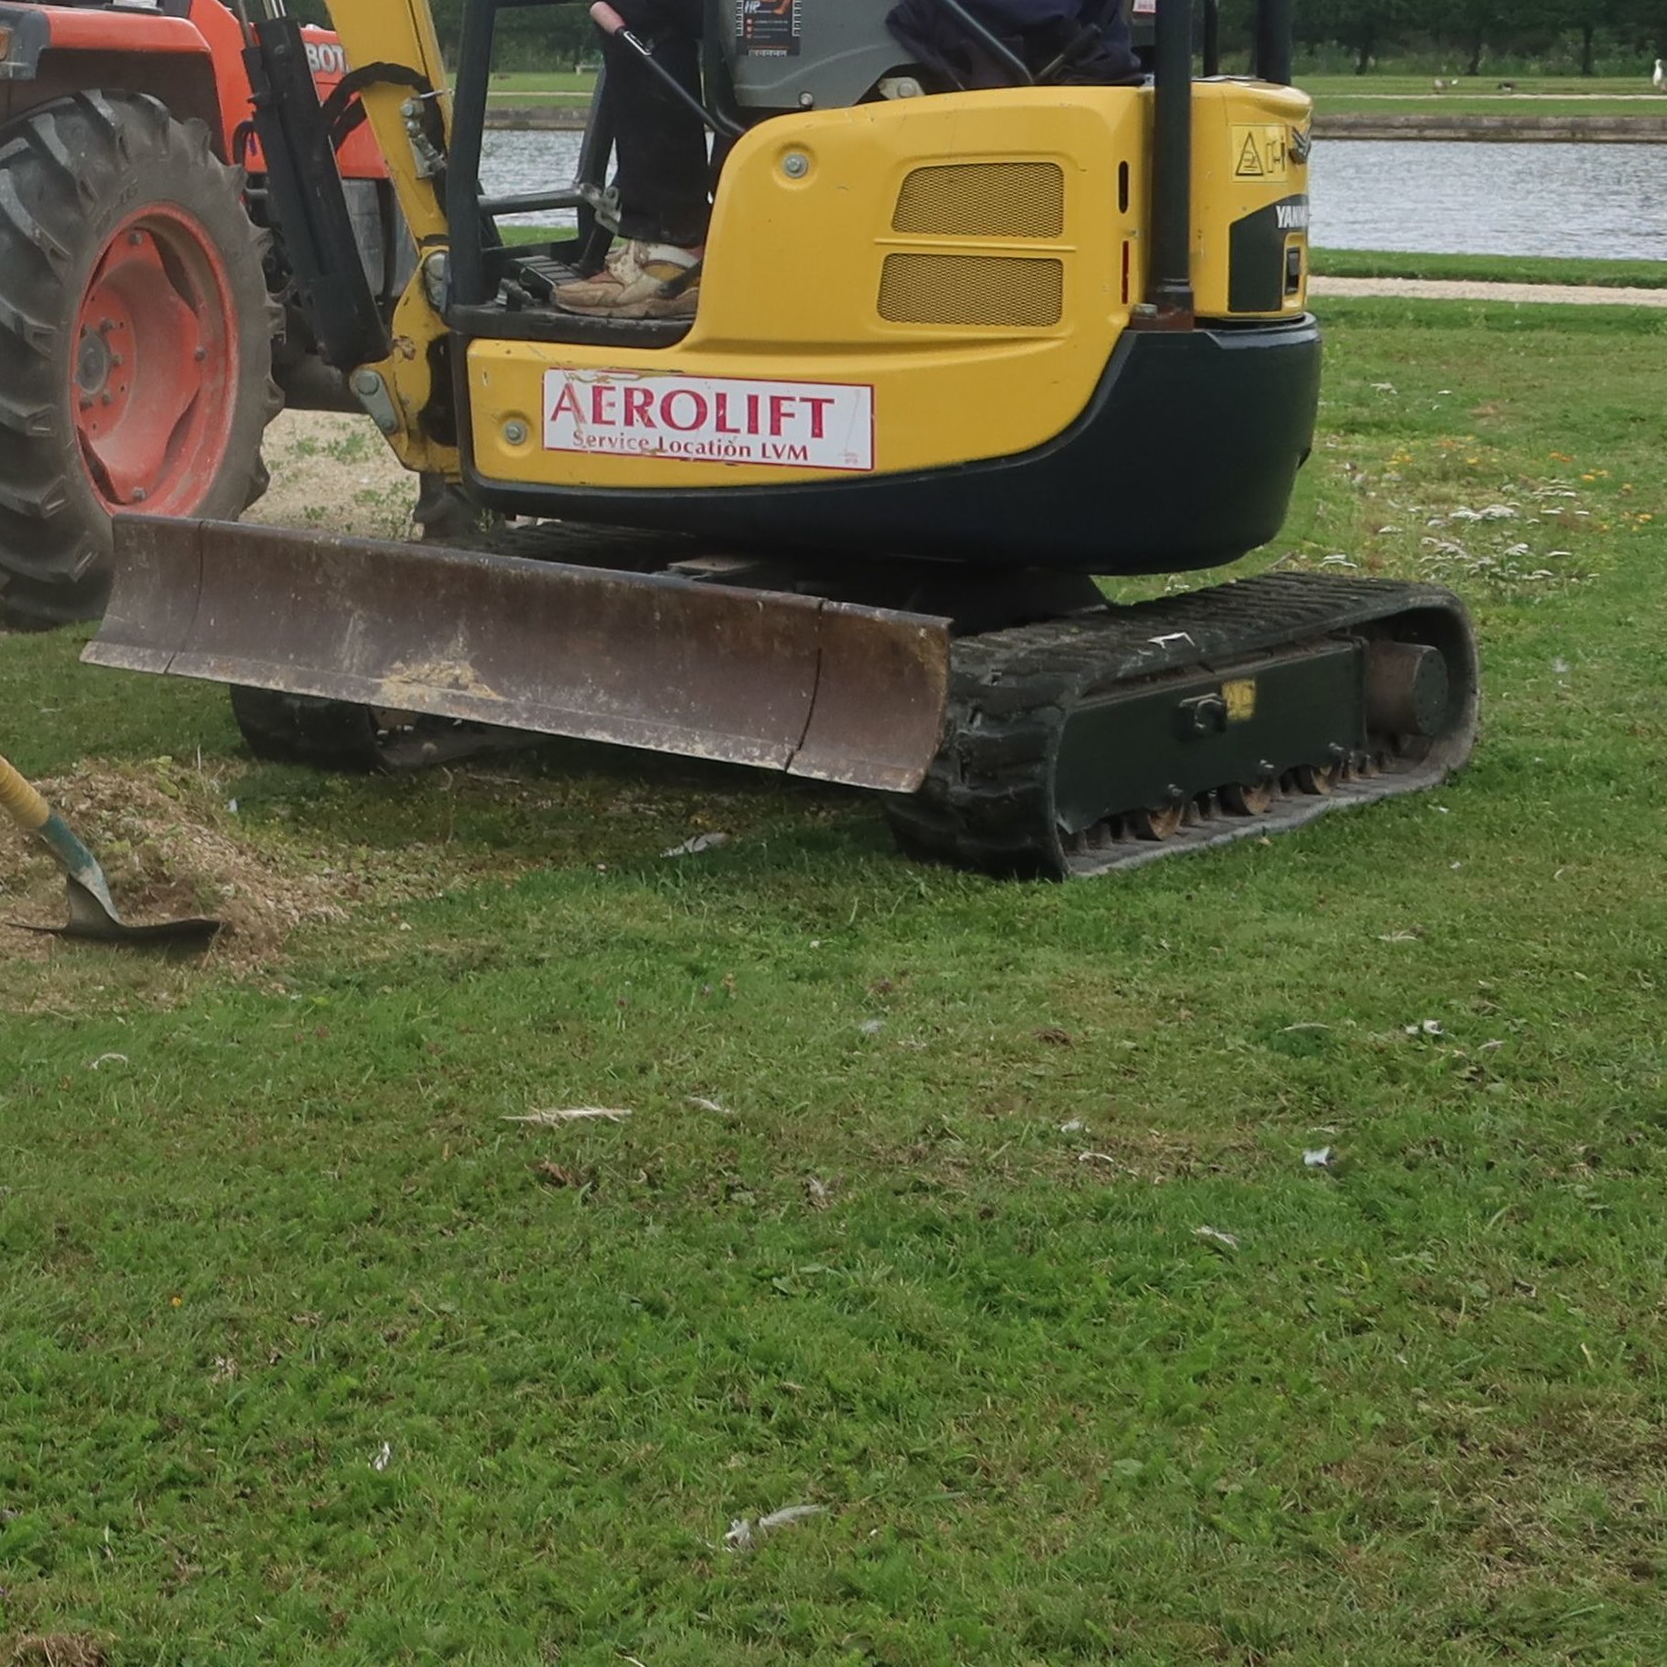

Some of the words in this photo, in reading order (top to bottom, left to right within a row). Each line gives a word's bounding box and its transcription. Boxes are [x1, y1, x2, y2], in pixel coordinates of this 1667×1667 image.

[304, 42, 352, 75] BOT
[550, 383, 836, 440] AEROLIFT
[573, 430, 651, 450] Service
[658, 435, 752, 458] Location
[761, 442, 809, 461] LVM
